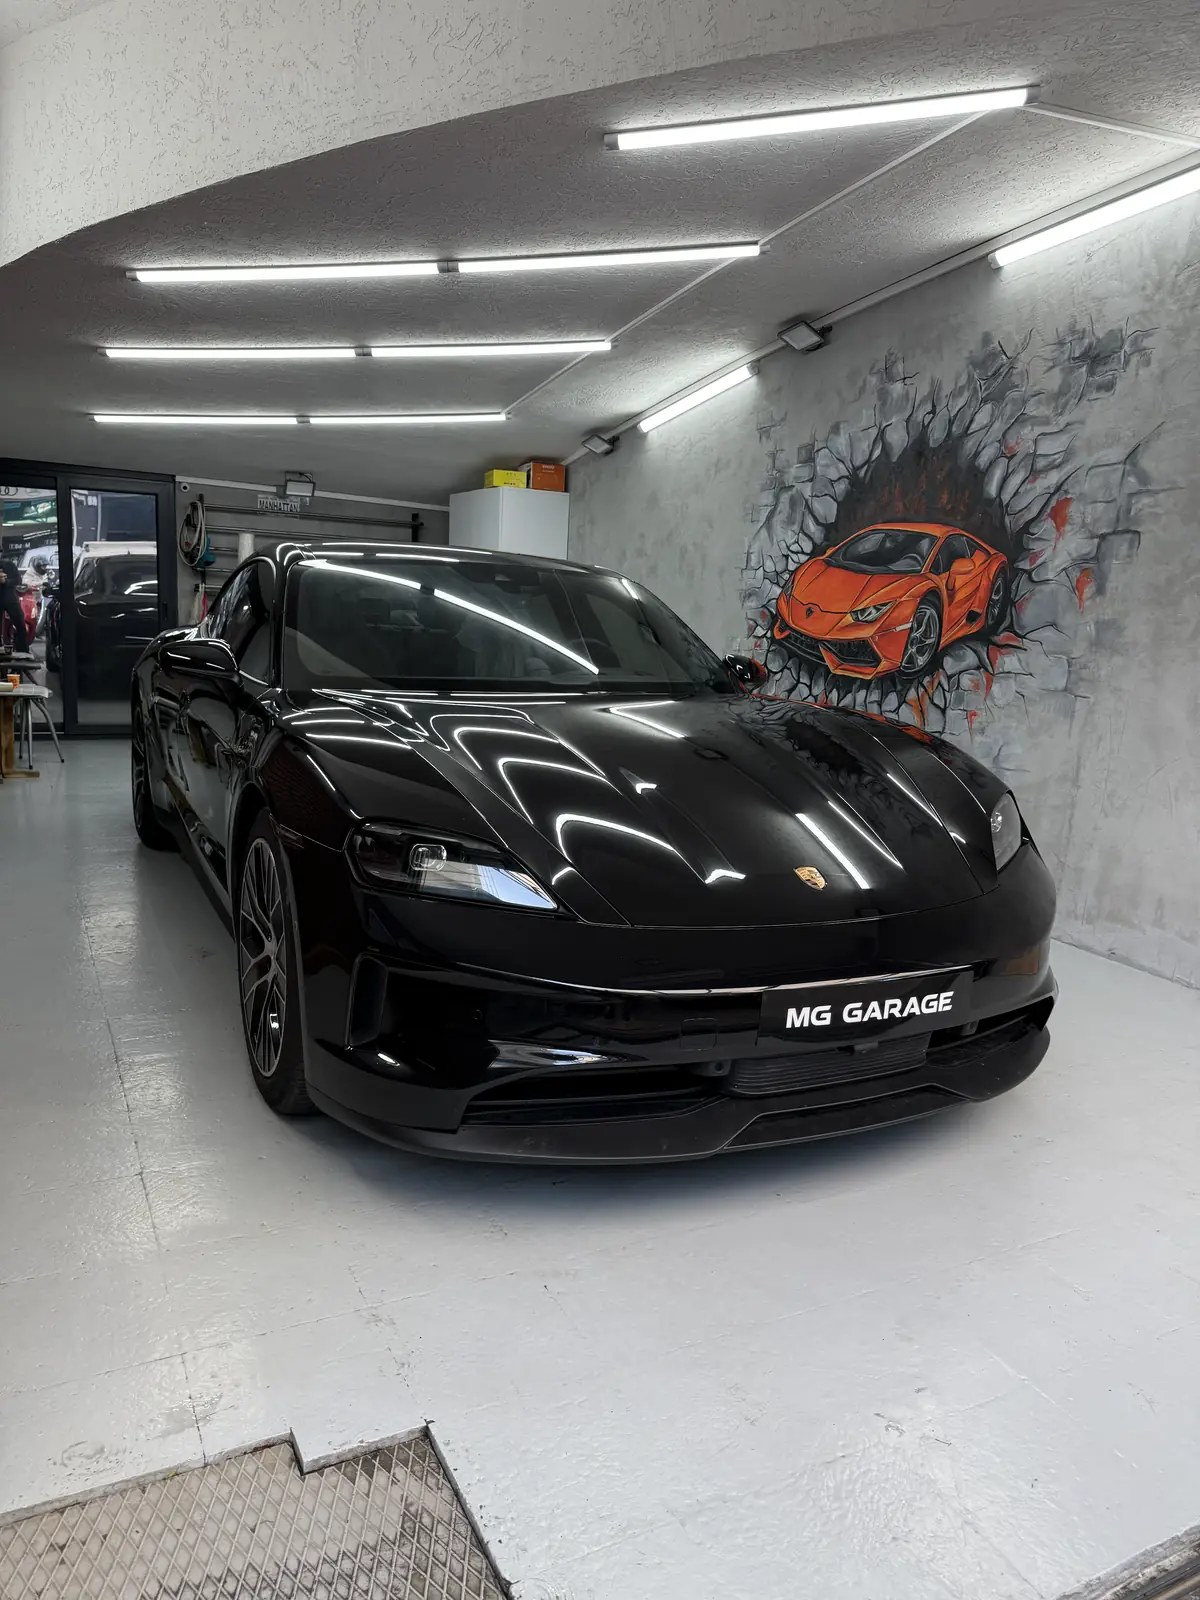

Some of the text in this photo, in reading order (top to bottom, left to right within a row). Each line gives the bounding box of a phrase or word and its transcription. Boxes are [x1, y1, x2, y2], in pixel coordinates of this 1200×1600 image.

[259, 499, 299, 512] MANHATTAN
[786, 991, 954, 1028] MG GARAGE
